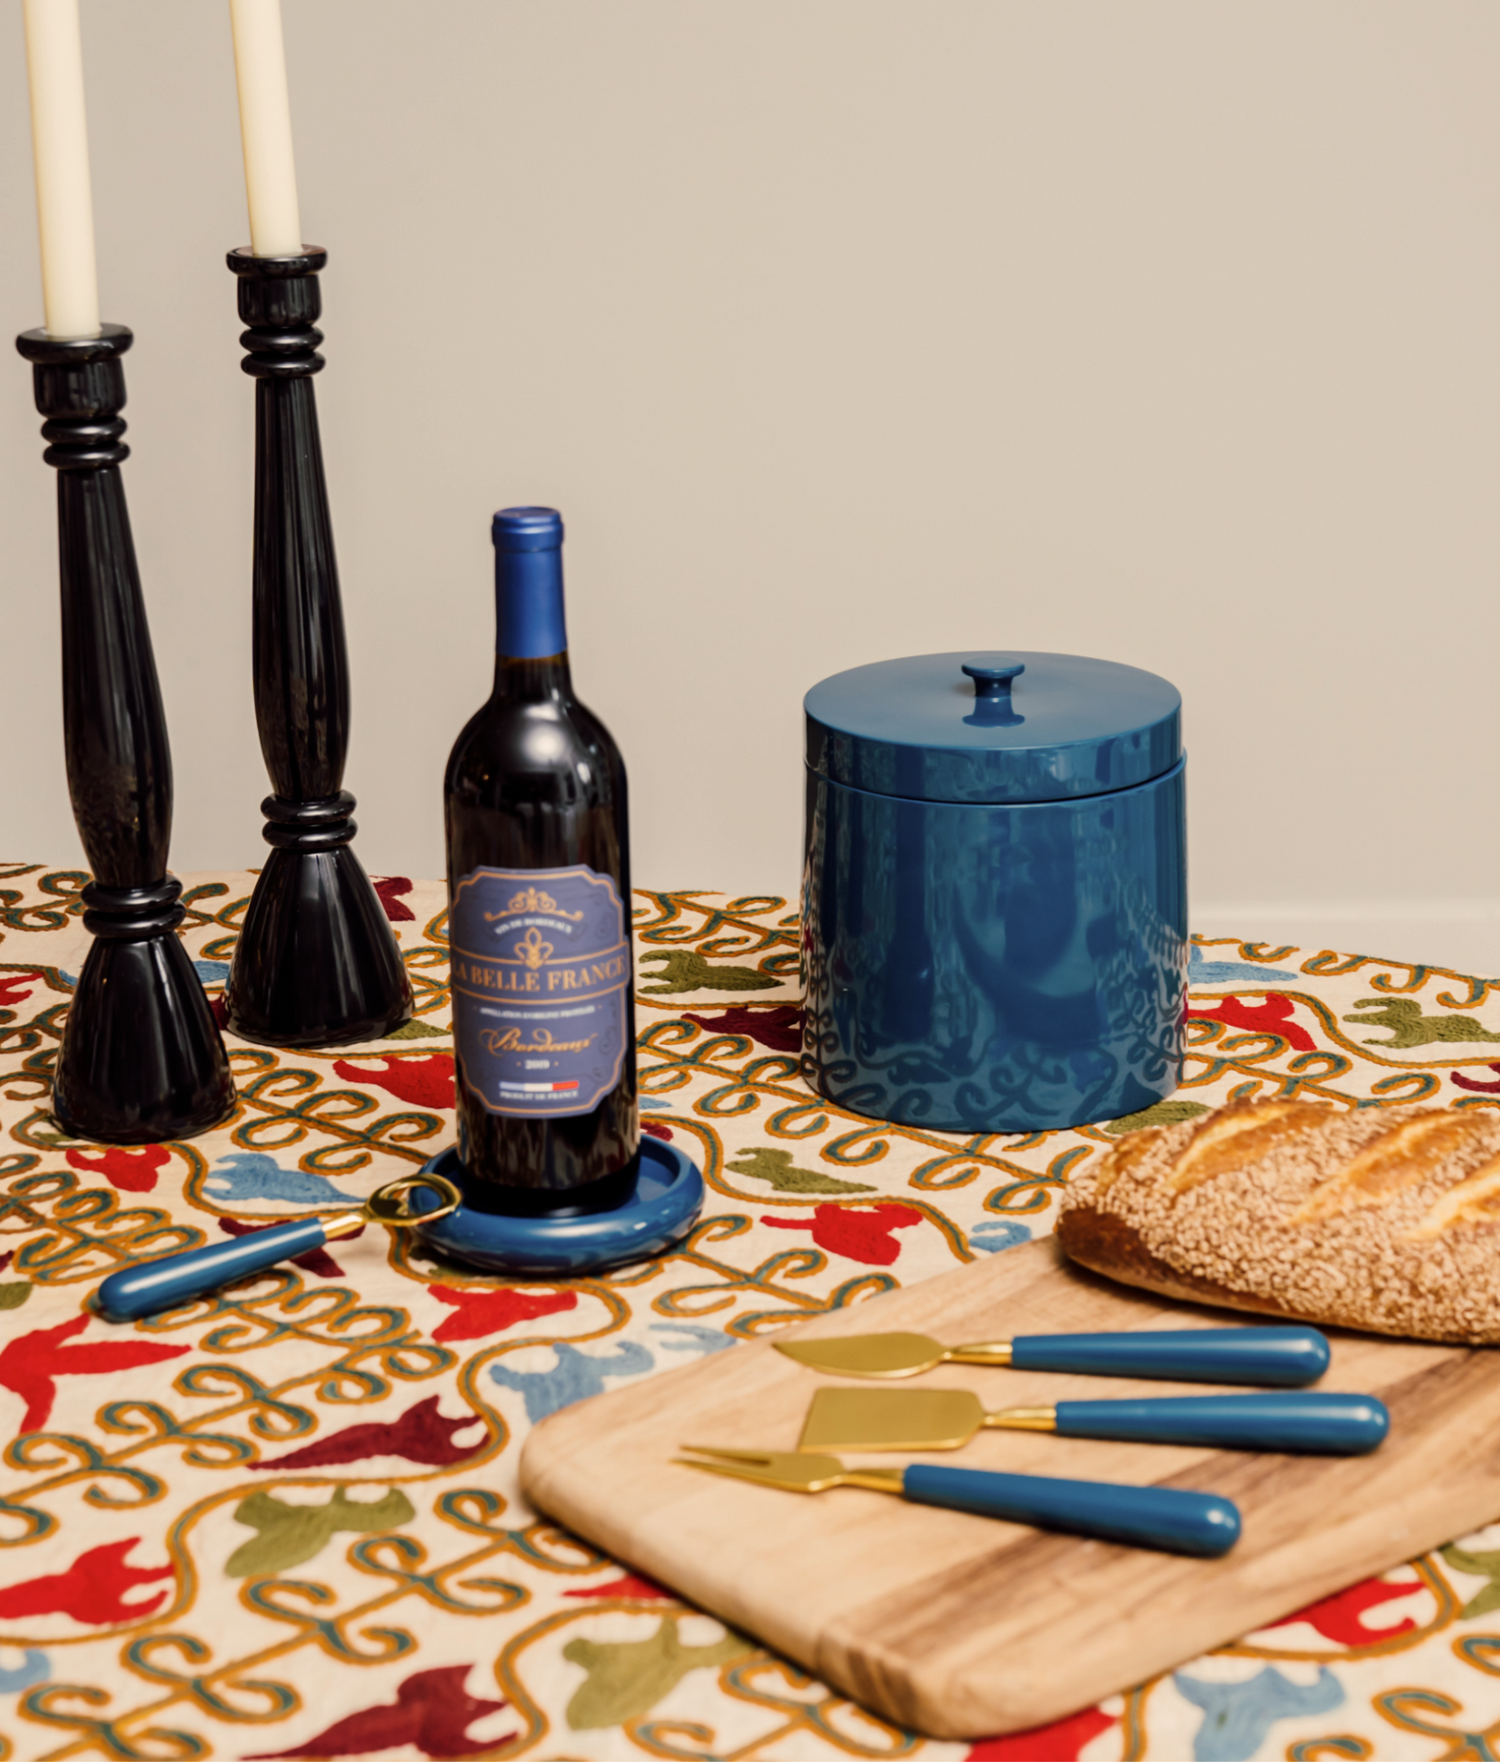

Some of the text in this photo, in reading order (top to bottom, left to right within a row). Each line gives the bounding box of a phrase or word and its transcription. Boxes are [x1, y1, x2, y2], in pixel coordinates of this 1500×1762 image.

[510, 919, 522, 929] DE
[524, 918, 572, 934] BORDEAUX
[452, 954, 626, 992] LA BELLE FRANCE
[478, 1026, 598, 1058] Bordeaux
[500, 1089, 578, 1100] PRODUIT DE FRANCE
